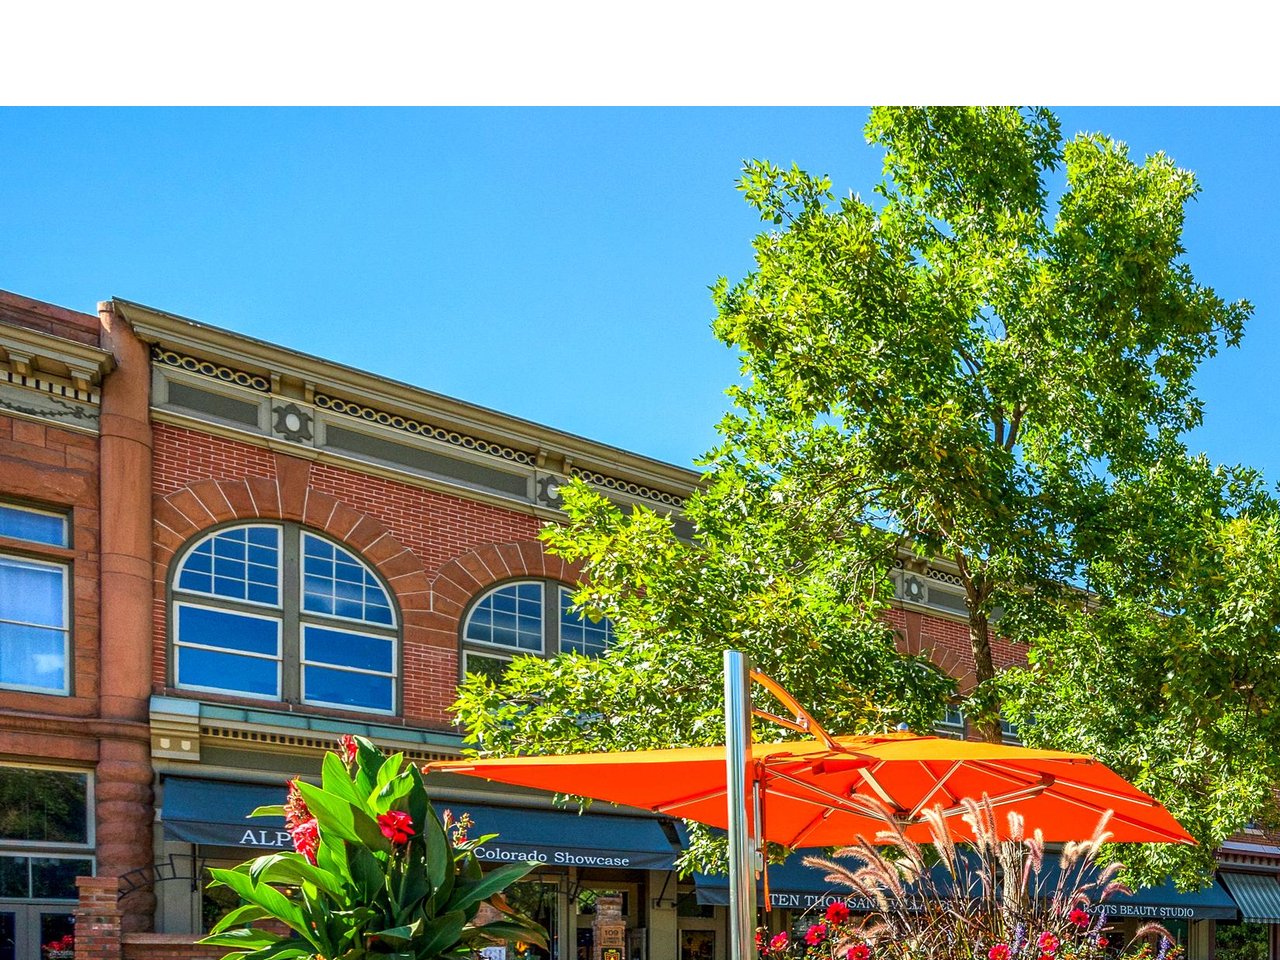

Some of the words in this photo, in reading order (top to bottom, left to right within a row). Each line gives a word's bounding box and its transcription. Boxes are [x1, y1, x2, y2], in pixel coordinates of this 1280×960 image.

[239, 829, 295, 847] ALP
[473, 847, 547, 862] Colorado
[554, 851, 630, 866] Showcase
[769, 893, 800, 906] TEN
[804, 895, 884, 909] THOUSAN
[1083, 903, 1117, 915] ROOTS
[1120, 905, 1158, 915] BEAUTY
[1160, 906, 1194, 917] STUDIO
